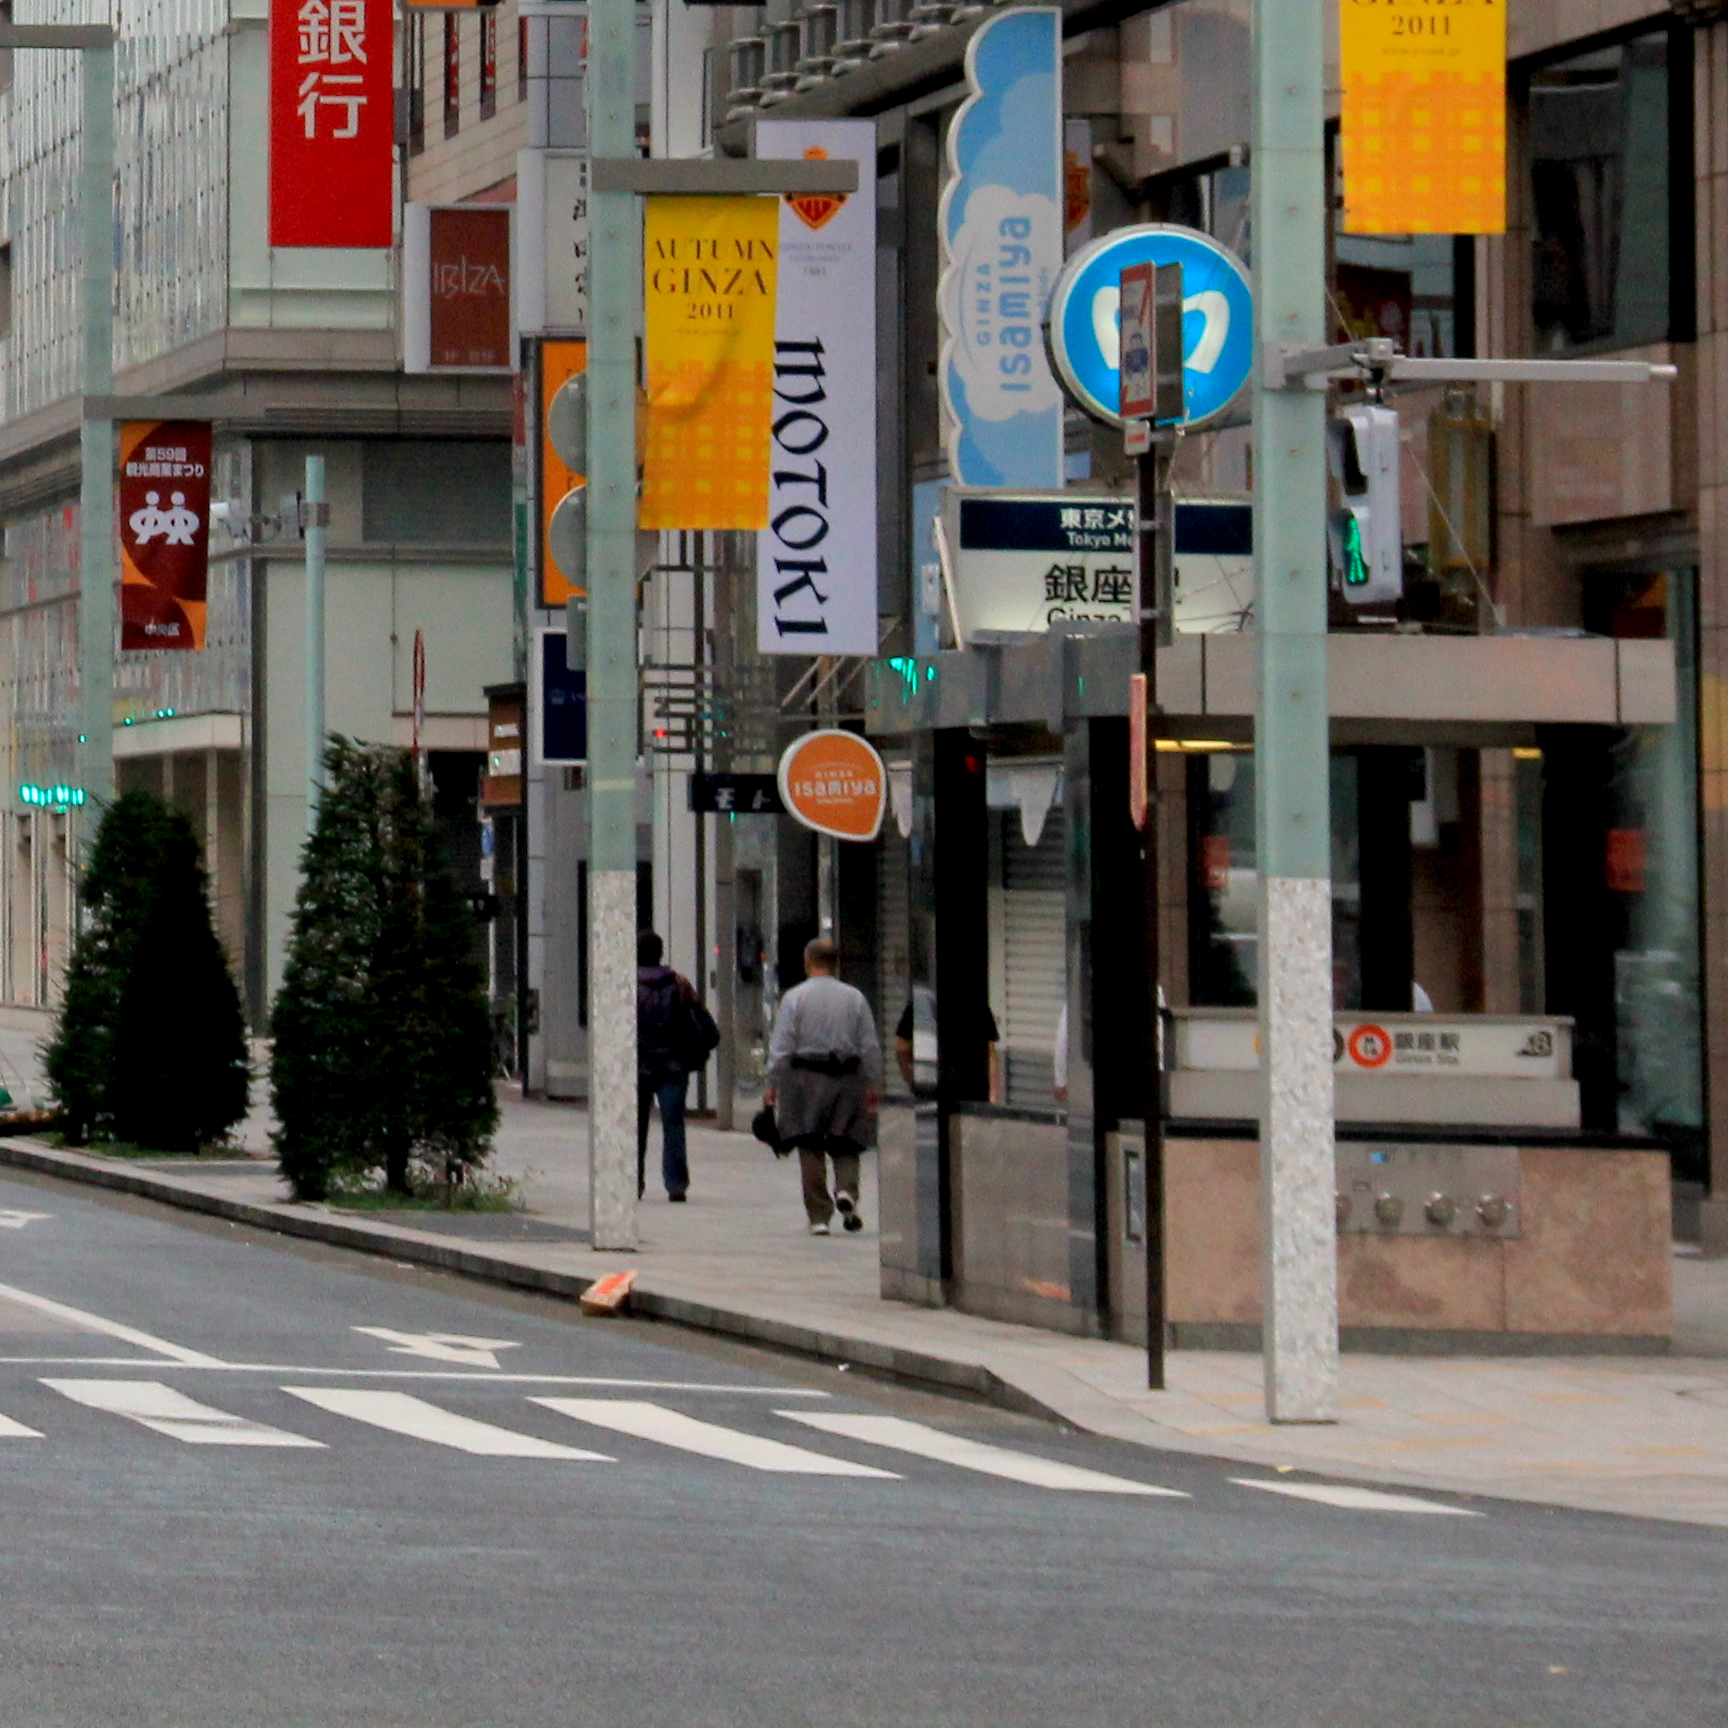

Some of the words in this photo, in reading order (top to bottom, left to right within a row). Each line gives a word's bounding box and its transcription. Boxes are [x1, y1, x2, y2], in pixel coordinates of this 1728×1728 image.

[1391, 13, 1453, 37] 2011
[650, 237, 776, 262] AUTUMN
[652, 267, 769, 296] GINZA
[685, 301, 736, 321] 2011
[976, 263, 991, 346] GINZA
[1067, 530, 1110, 550] Tokyo
